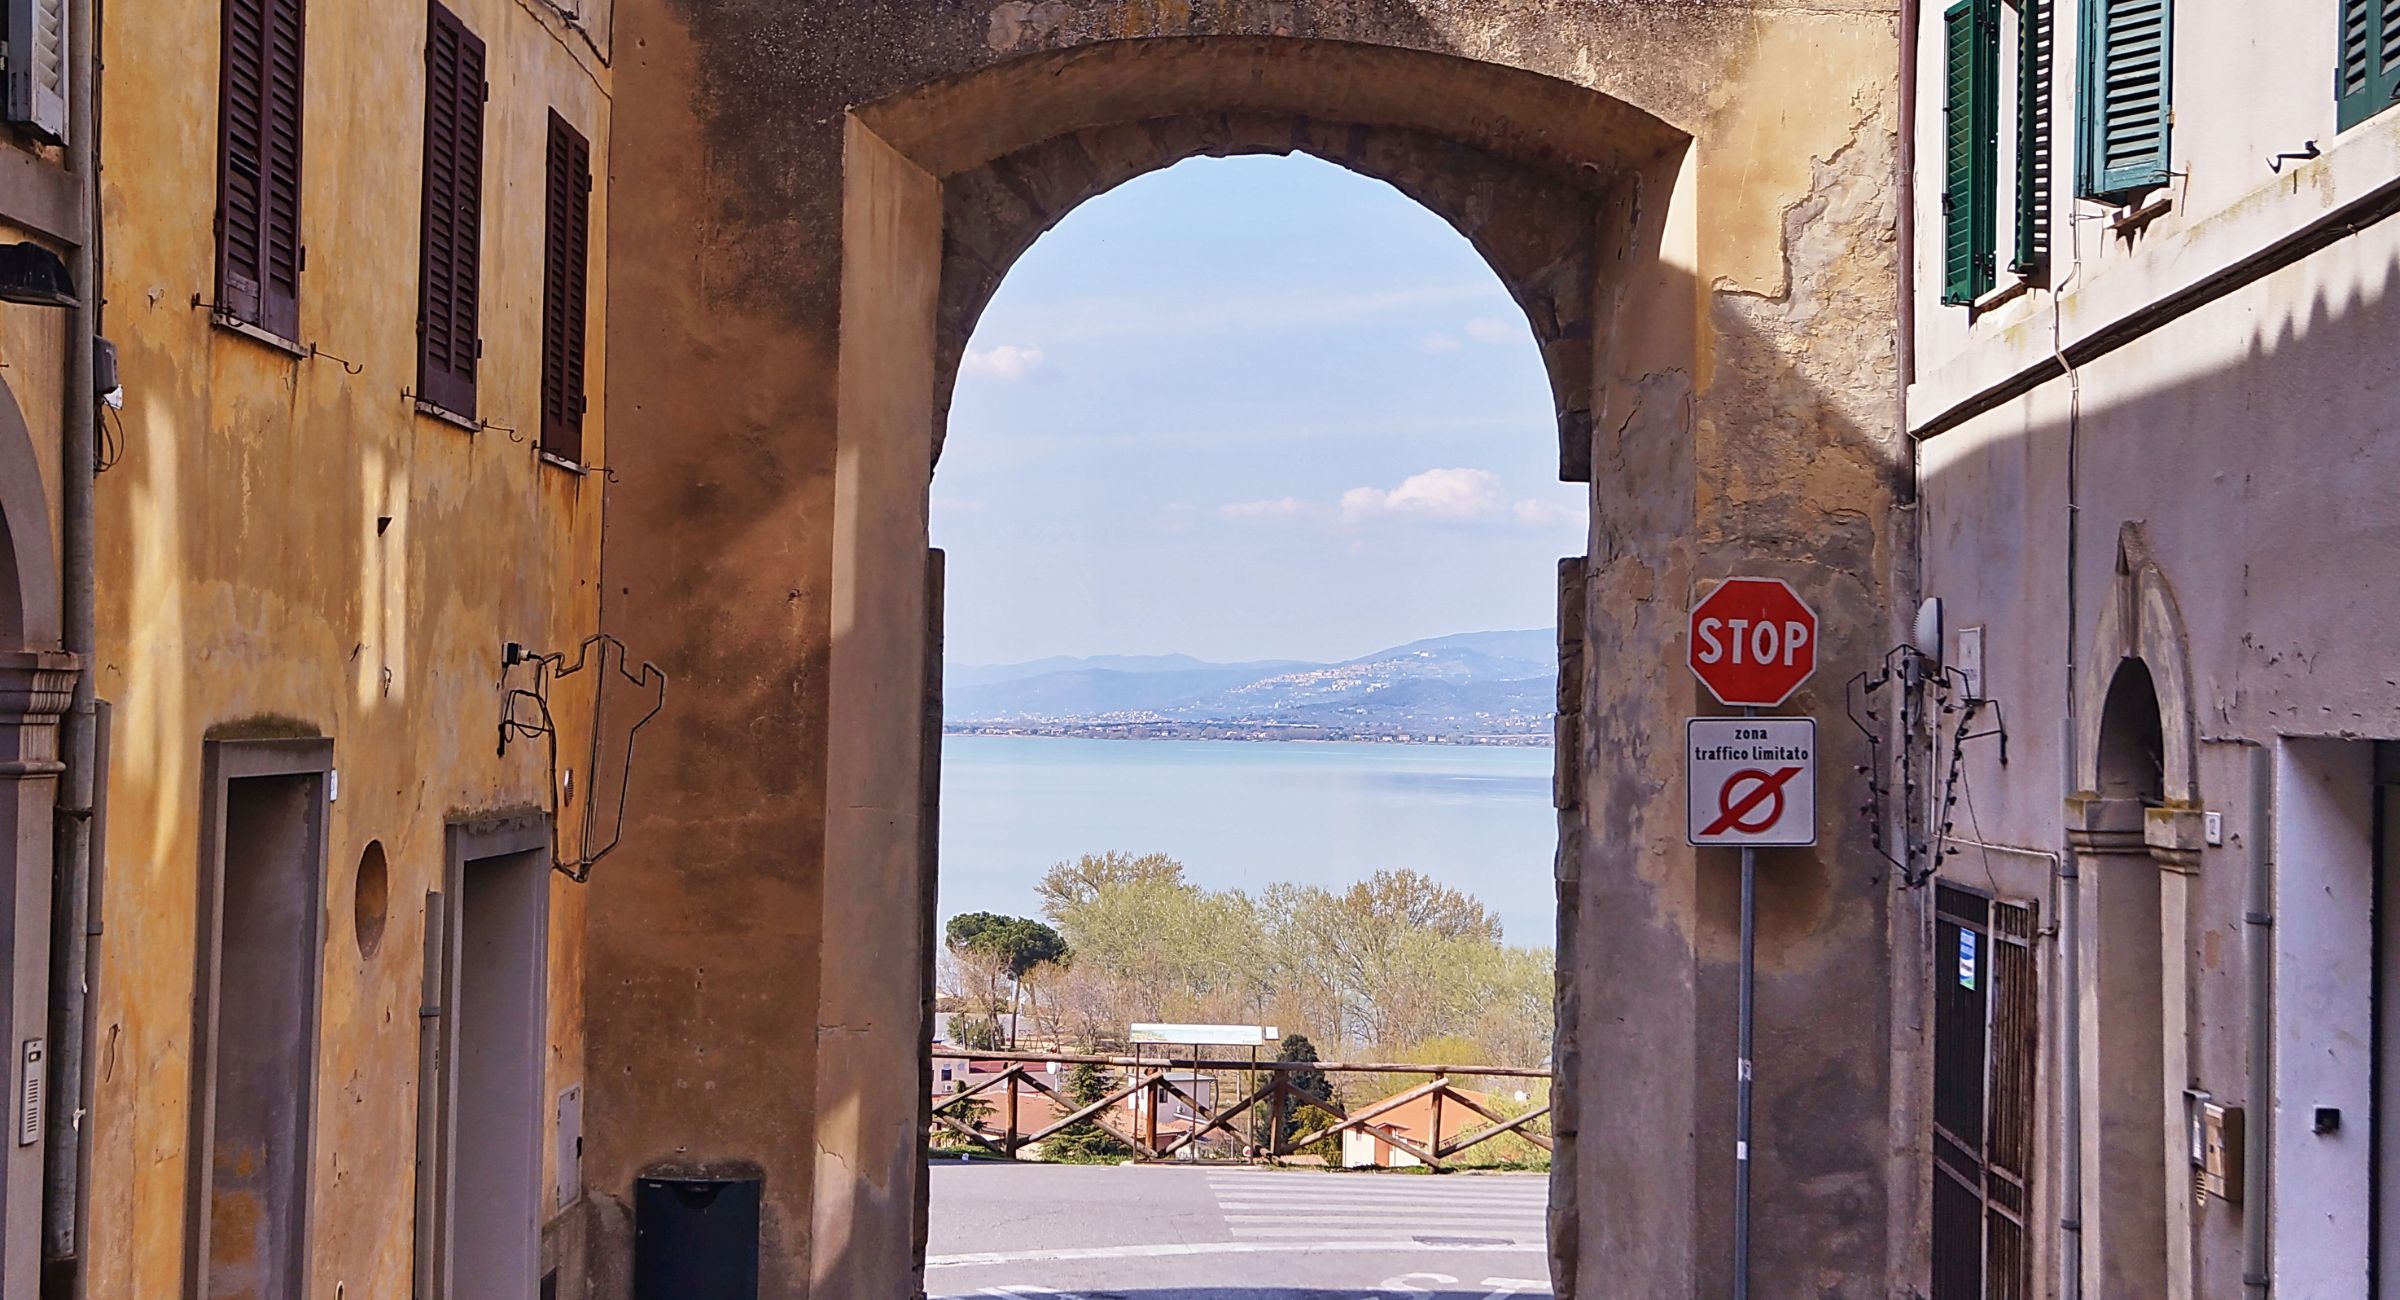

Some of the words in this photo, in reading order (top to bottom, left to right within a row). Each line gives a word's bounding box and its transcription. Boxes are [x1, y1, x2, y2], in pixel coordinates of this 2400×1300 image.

[1698, 617, 1809, 667] STOP
[1734, 729, 1768, 740] zona
[1695, 746, 1749, 761] traffico
[1752, 746, 1809, 761] limitato
